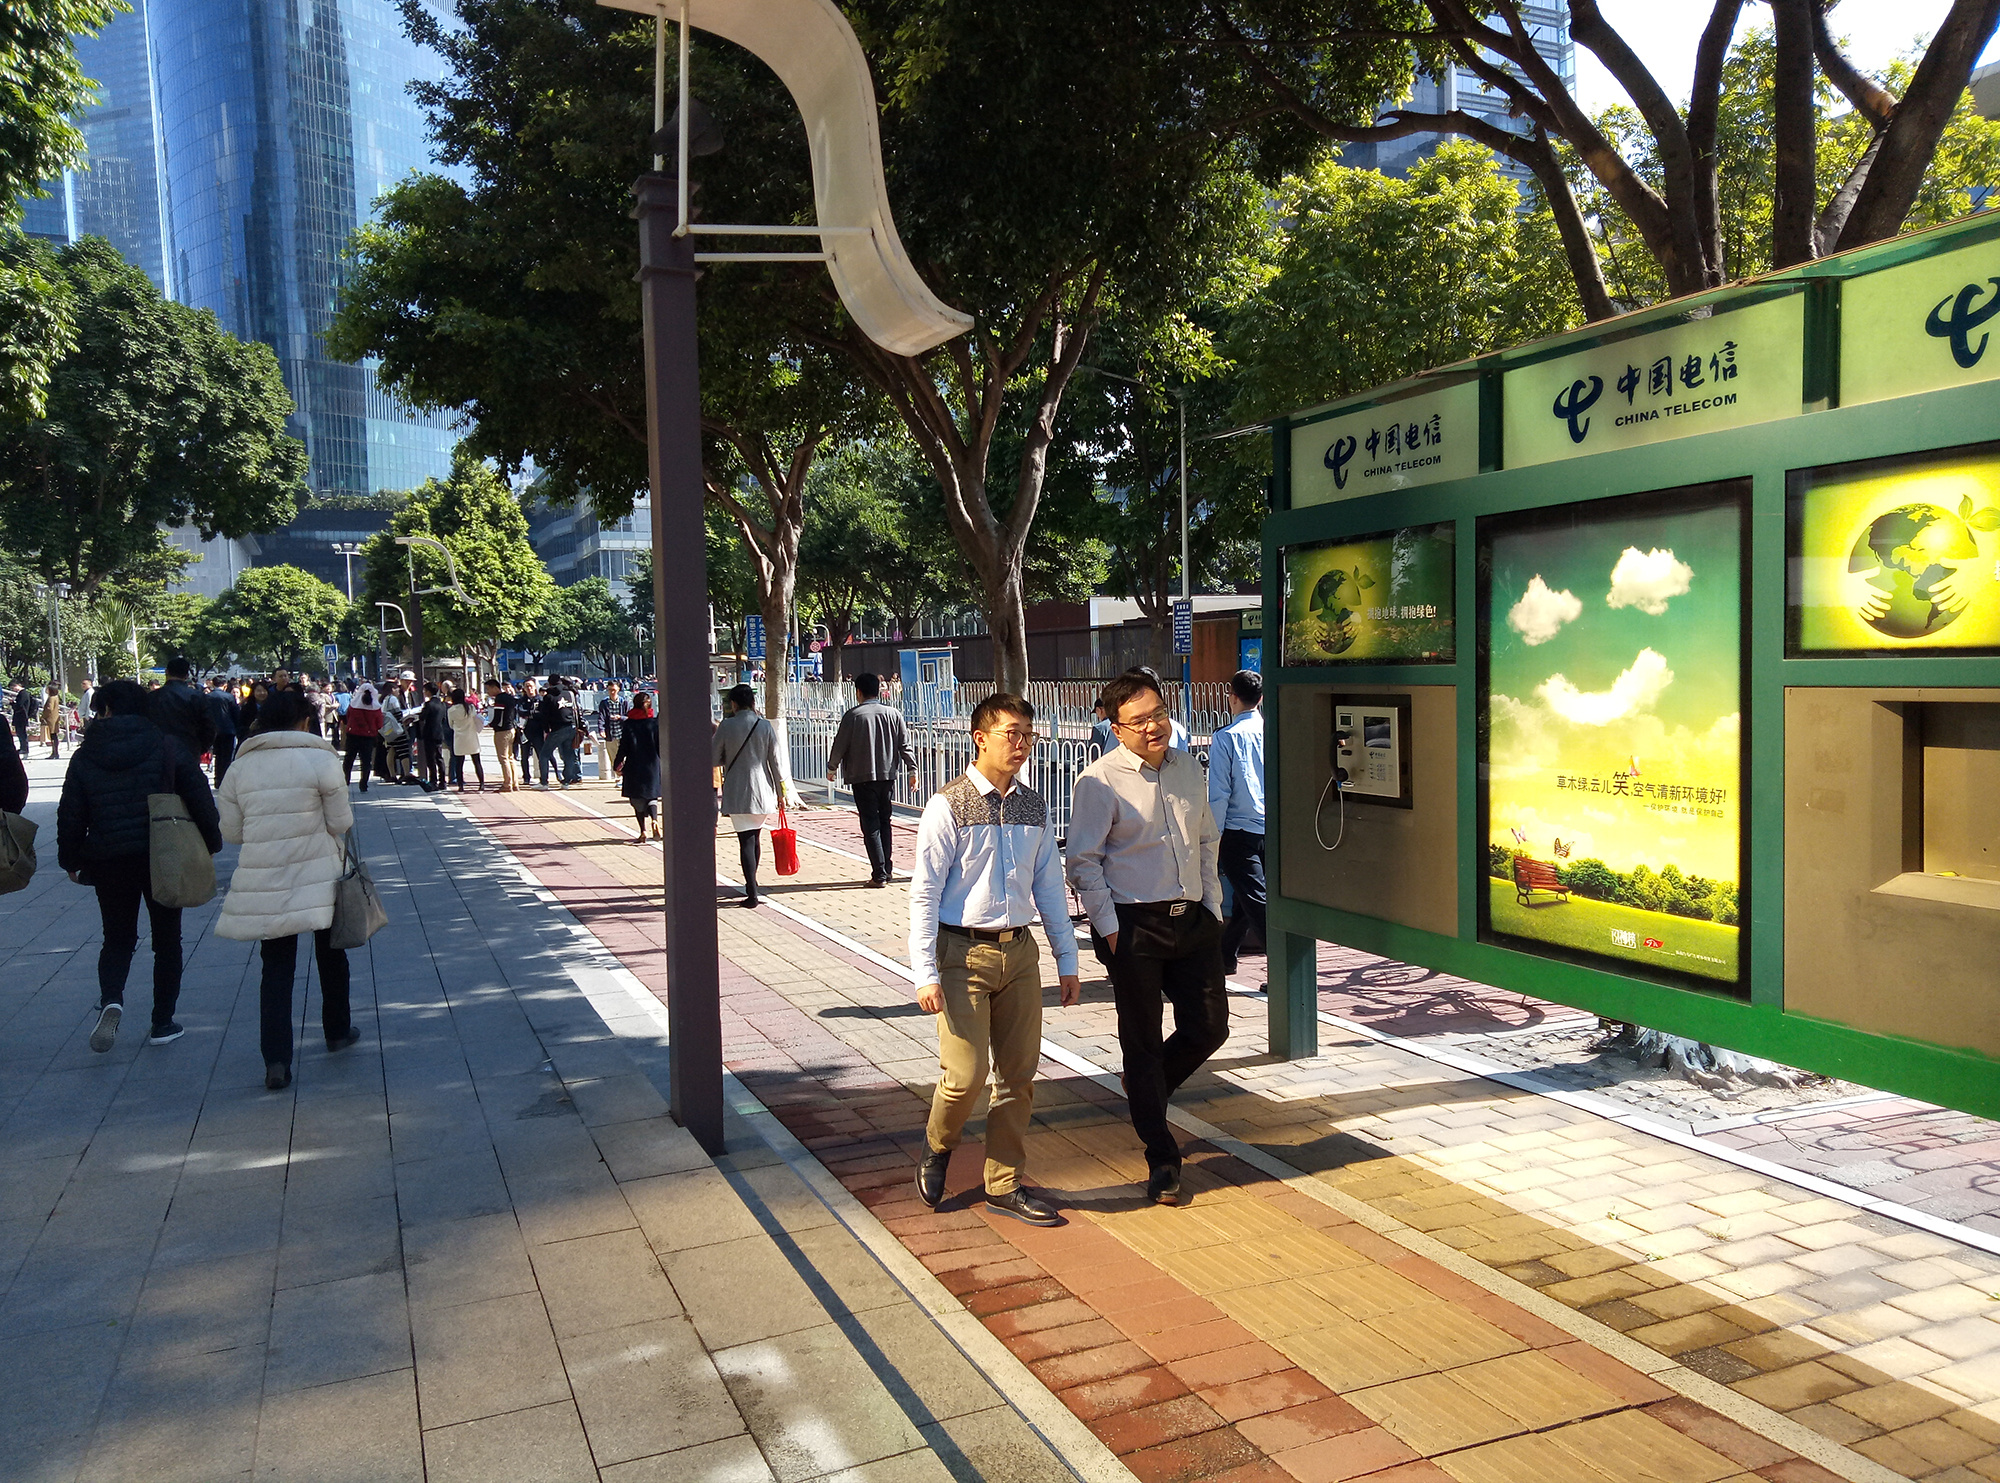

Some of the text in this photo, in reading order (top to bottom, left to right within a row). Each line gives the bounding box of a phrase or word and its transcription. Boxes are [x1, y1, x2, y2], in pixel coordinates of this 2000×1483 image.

[1616, 340, 1739, 406] 中国电信
[1615, 393, 1738, 427] CHINA TELECOM
[1364, 413, 1442, 462] 中国电信
[1363, 455, 1442, 478] CHINA TELECOM
